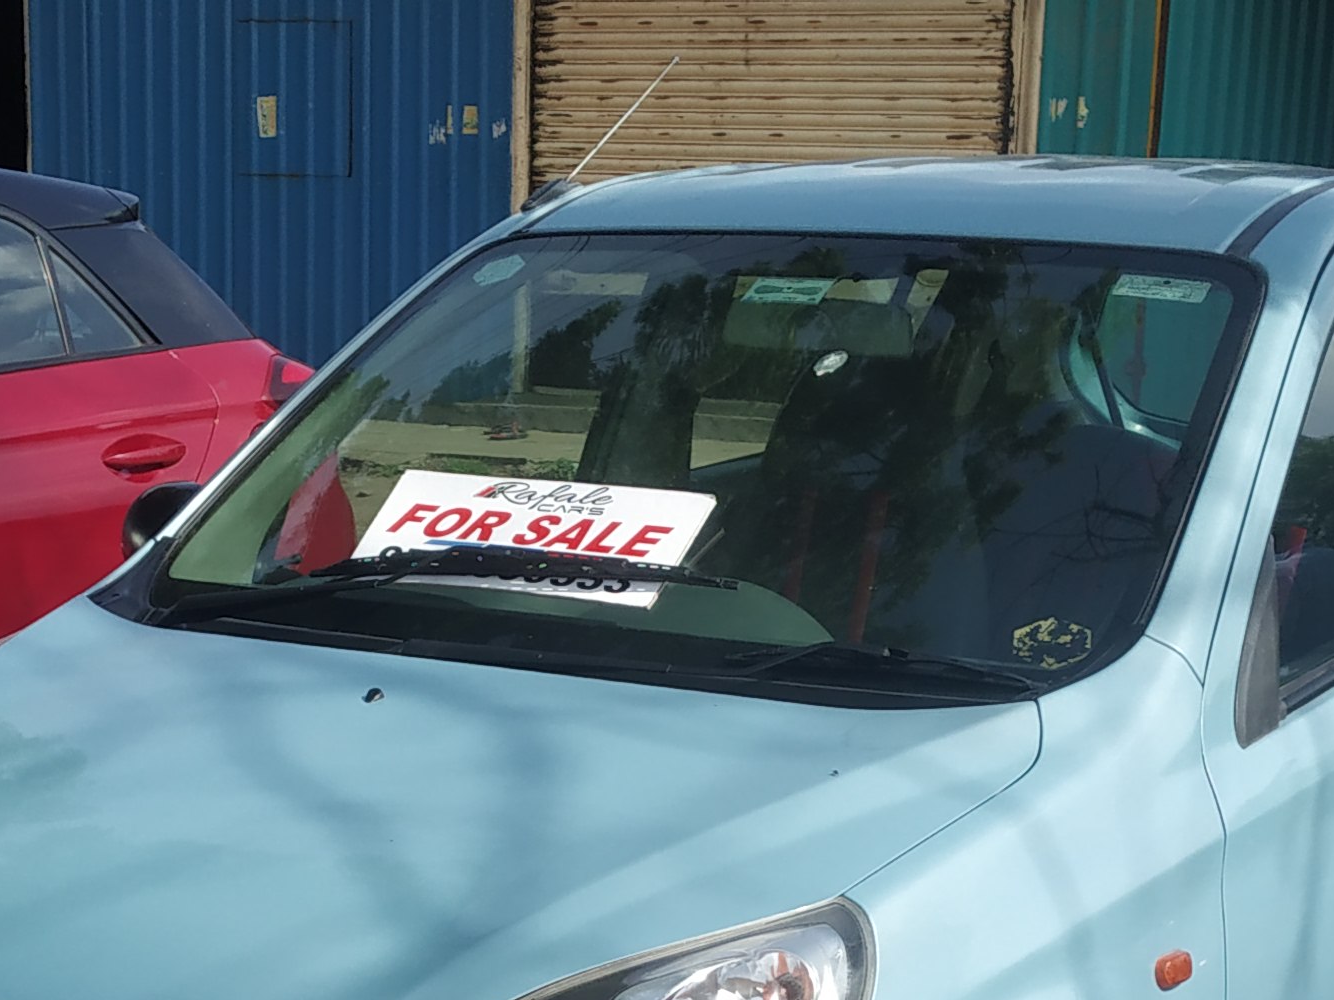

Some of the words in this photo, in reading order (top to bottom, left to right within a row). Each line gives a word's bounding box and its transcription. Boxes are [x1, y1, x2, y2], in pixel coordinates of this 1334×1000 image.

[491, 481, 614, 510] Rafale
[536, 503, 605, 516] CAR'S
[386, 503, 513, 542] FOR
[512, 515, 675, 557] SALE
